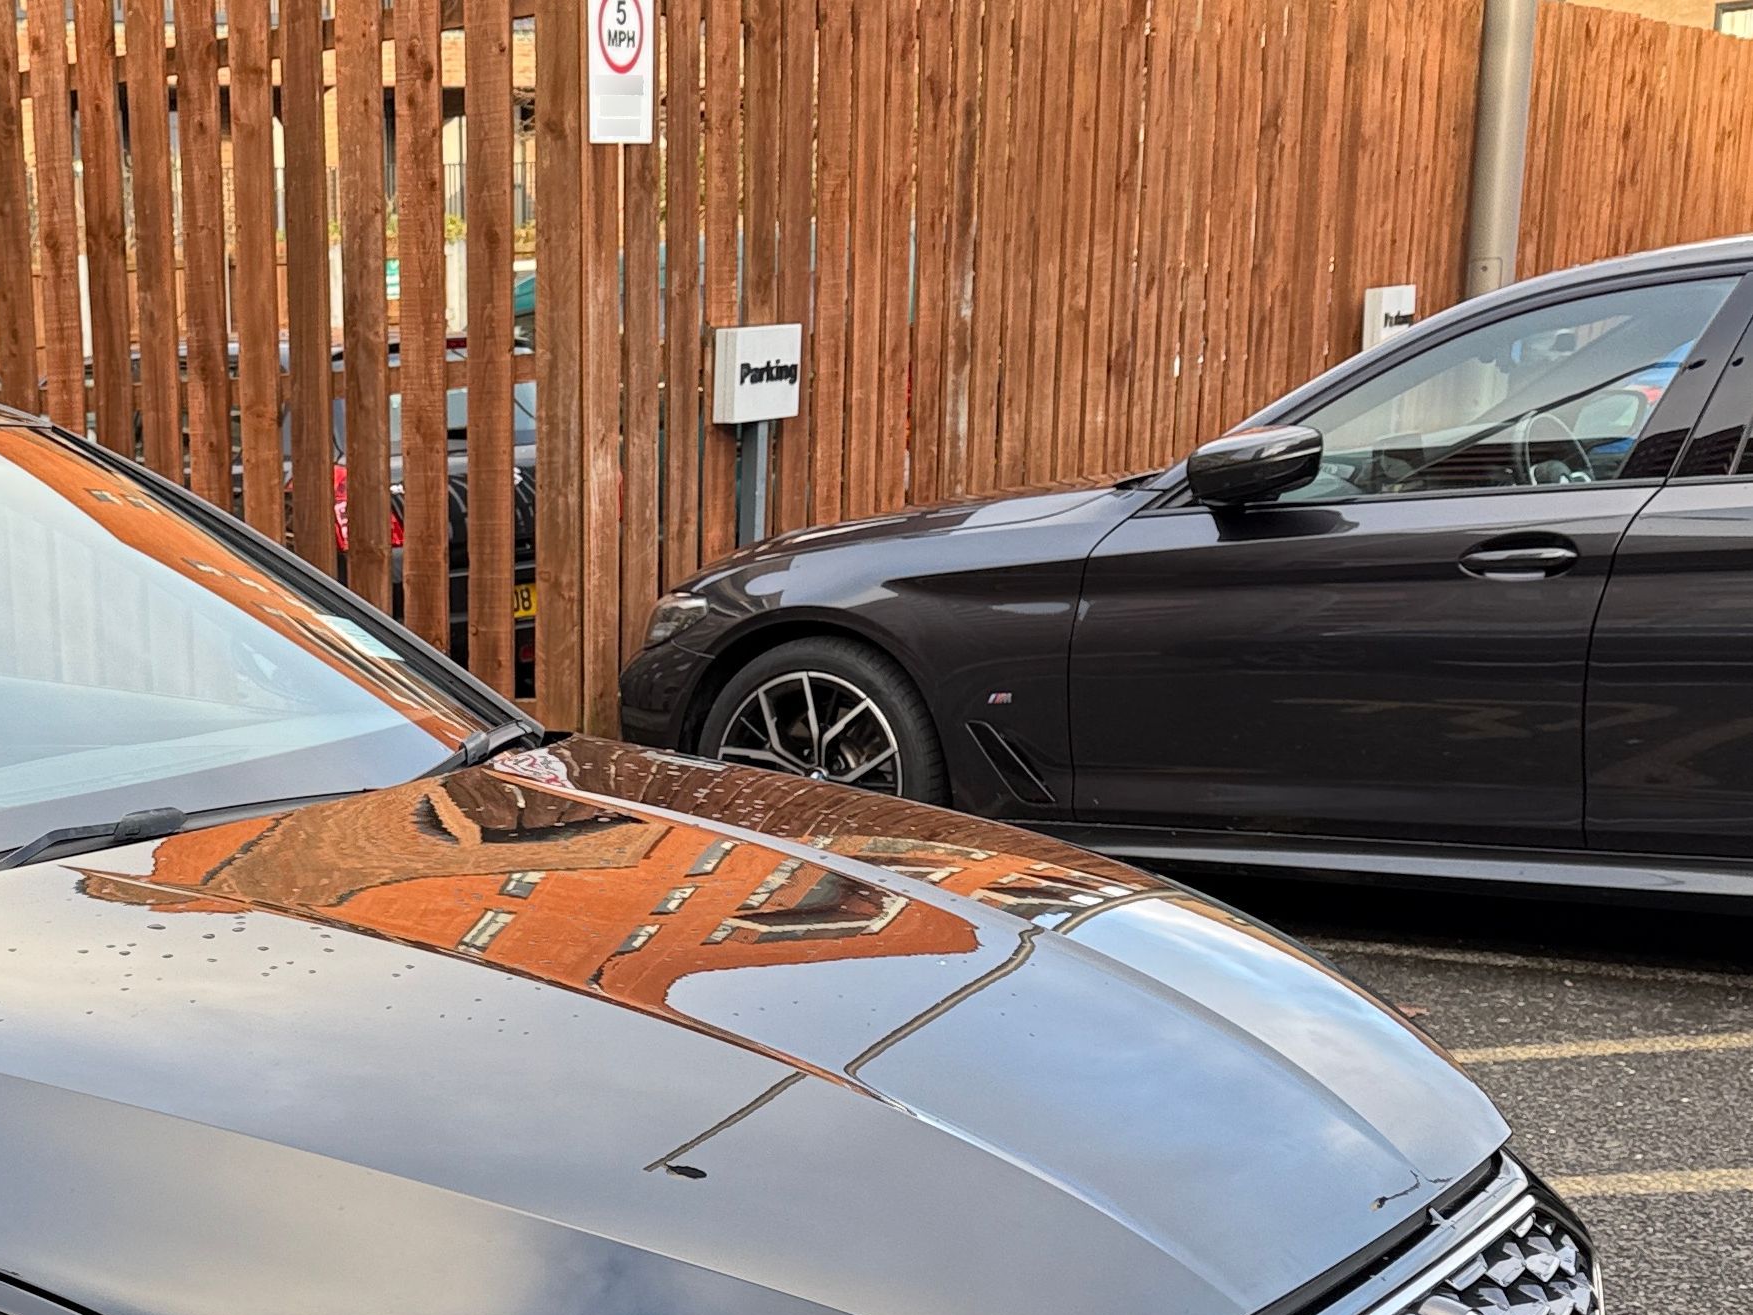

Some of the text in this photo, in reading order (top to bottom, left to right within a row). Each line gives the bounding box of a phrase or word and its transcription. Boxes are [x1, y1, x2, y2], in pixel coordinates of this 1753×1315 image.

[616, 0, 627, 25] 5
[607, 29, 636, 48] MPH
[740, 359, 798, 386] Parking
